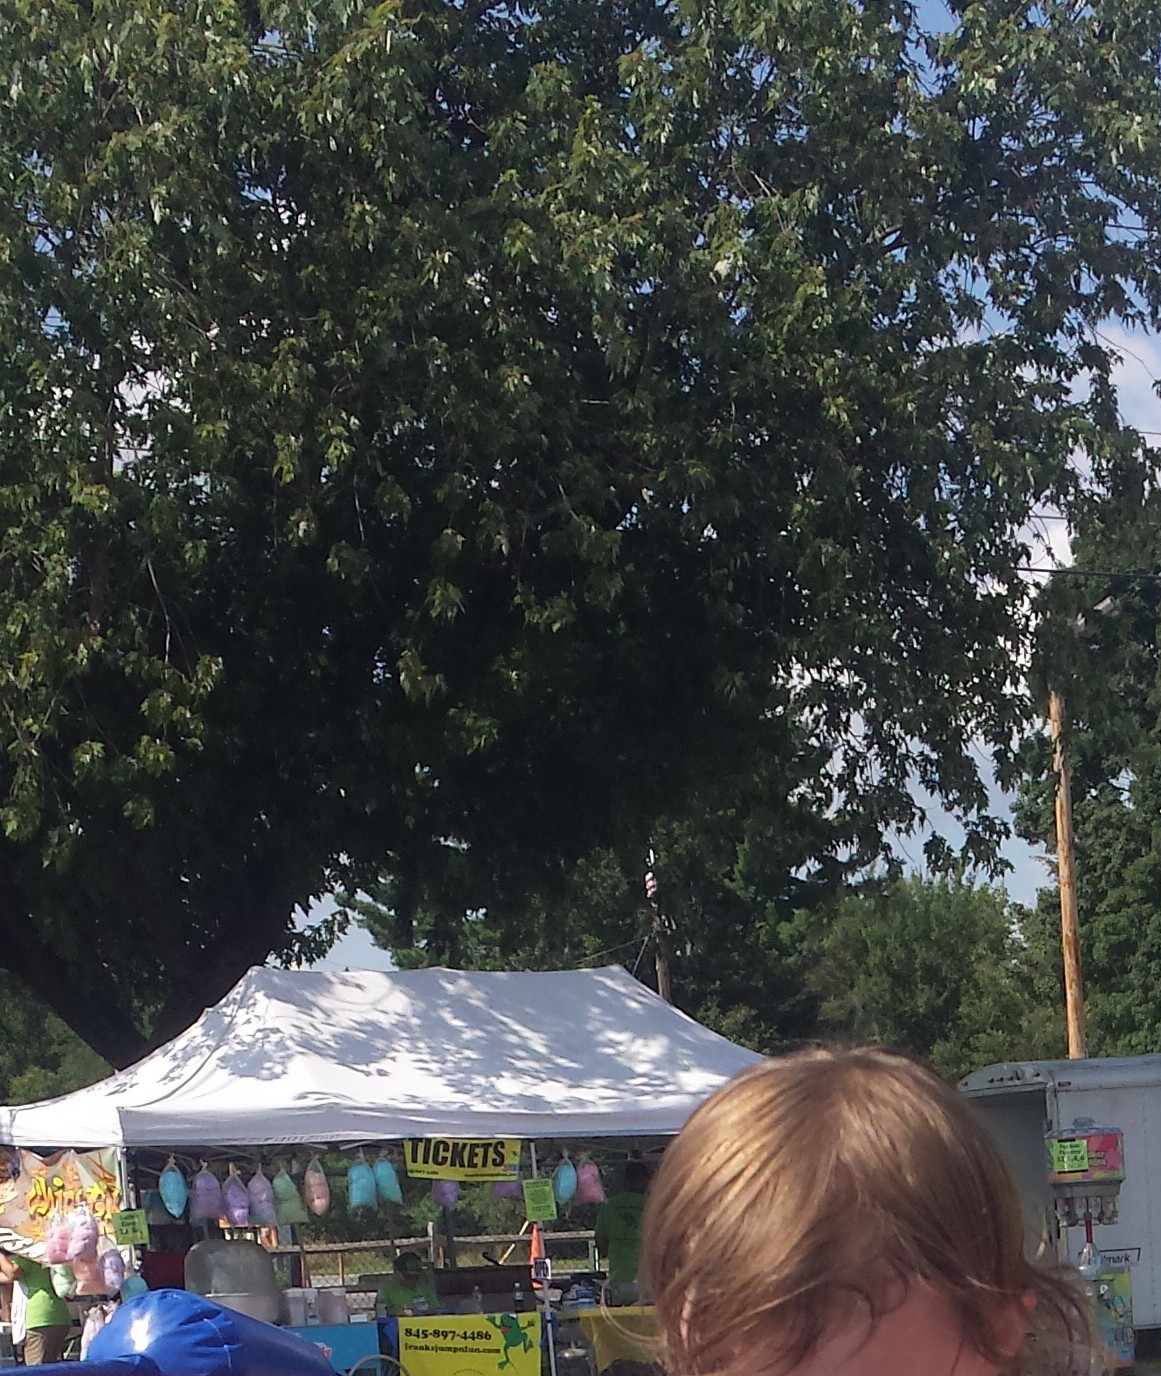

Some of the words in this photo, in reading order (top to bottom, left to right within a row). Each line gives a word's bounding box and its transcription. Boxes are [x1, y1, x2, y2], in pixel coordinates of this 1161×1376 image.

[408, 1138, 506, 1168] TICKETS
[404, 1328, 492, 1342] 845-897-4486
[404, 1342, 501, 1355] franksjumpnfun.com
